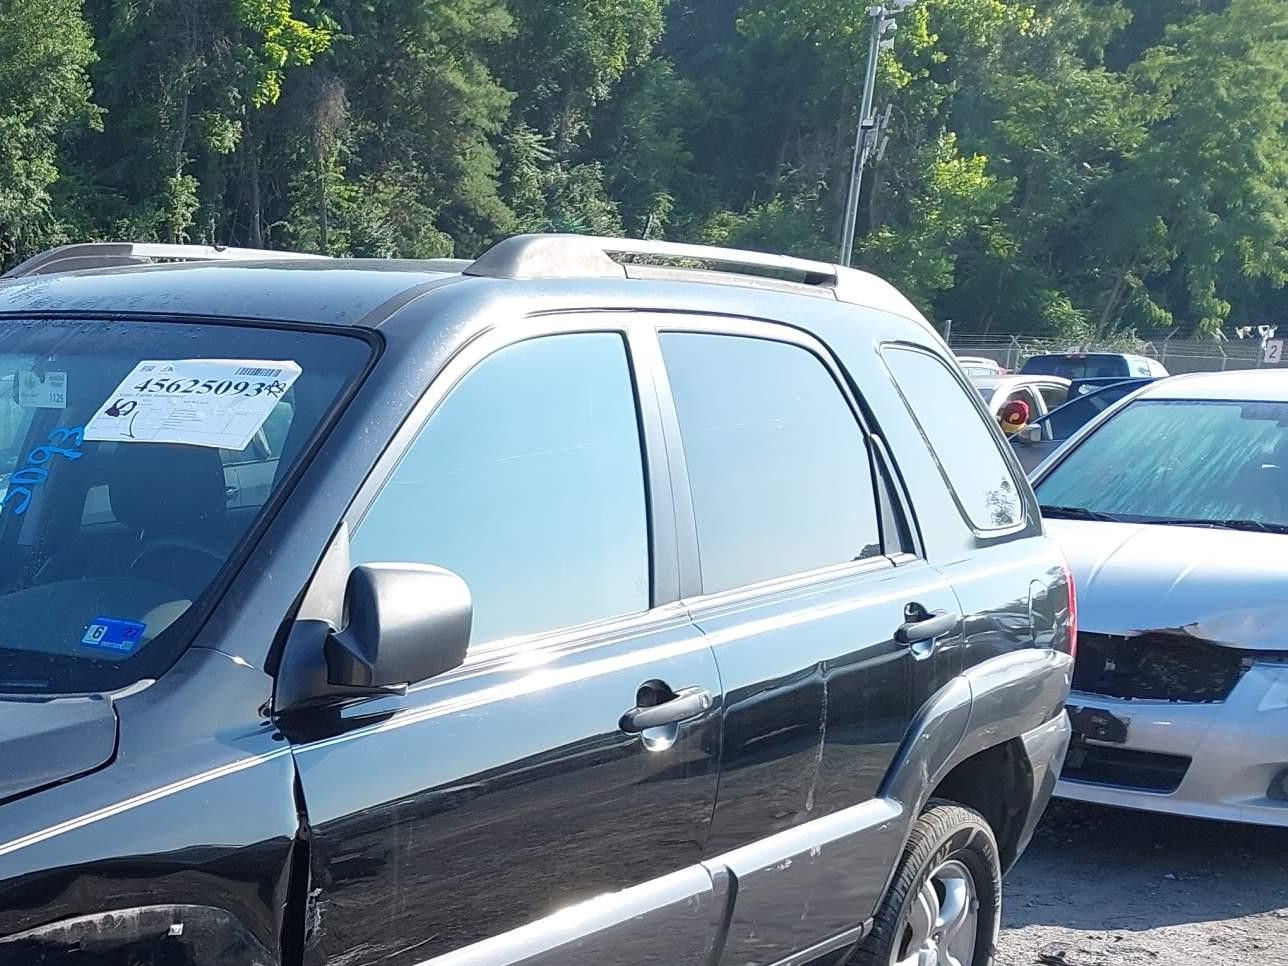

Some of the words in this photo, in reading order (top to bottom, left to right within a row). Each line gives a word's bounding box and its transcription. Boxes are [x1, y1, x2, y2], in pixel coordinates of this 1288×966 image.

[1269, 345, 1278, 359] 2
[134, 377, 265, 397] 45625093
[92, 626, 105, 639] 6
